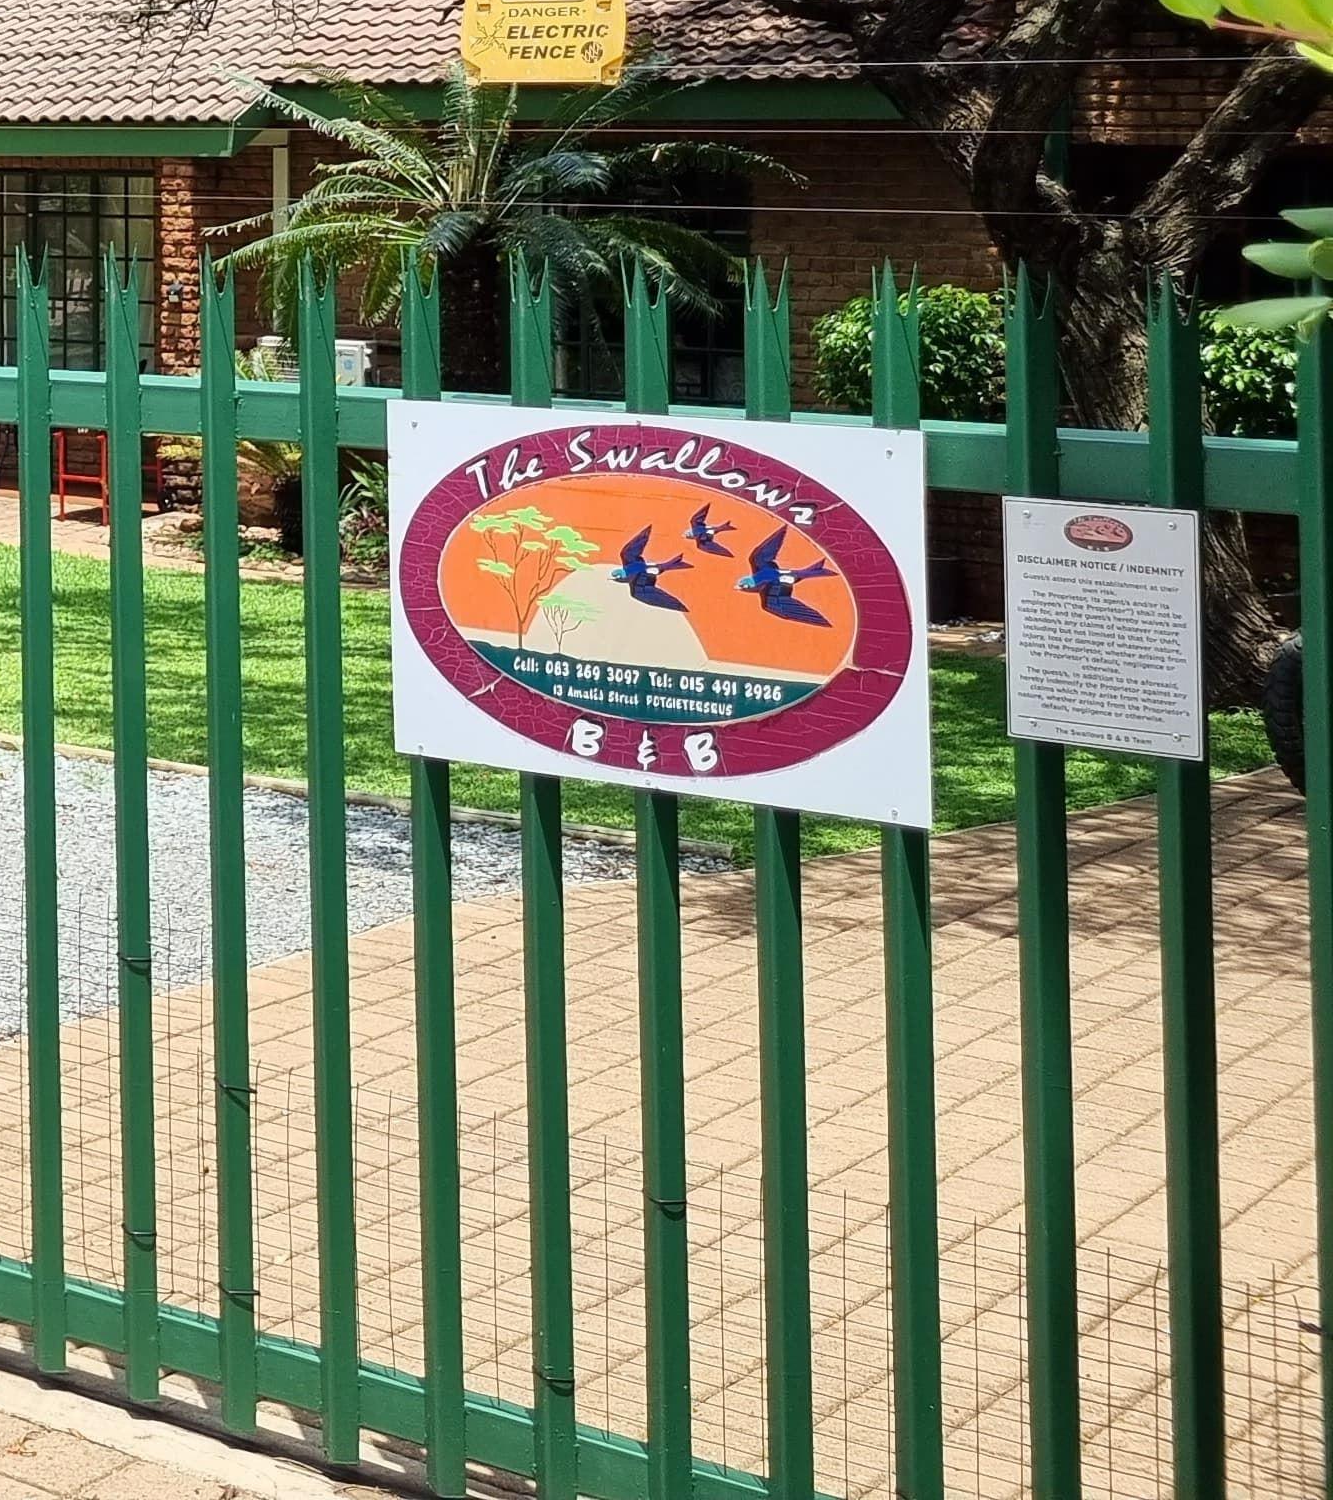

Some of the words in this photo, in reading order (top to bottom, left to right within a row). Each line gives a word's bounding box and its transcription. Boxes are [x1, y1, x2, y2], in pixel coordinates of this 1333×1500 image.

[508, 7, 580, 18] DANGER
[506, 24, 609, 40] ELECTRIC
[508, 45, 576, 60] FENCE
[465, 445, 543, 499] The
[567, 431, 816, 525] Swallows
[1017, 554, 1077, 567] DISCLAIMER
[1080, 560, 1116, 570] NOTICE
[1126, 564, 1184, 577] INDEMNITY
[1051, 575, 1075, 583] attend
[1094, 578, 1147, 589] establishment
[1159, 584, 1178, 592] their
[1079, 620, 1103, 628] claims
[1116, 624, 1151, 633] whatever
[1113, 615, 1137, 624] hereby
[1022, 623, 1056, 633] including
[1018, 639, 1045, 649] against
[1105, 649, 1135, 657] whether
[1138, 652, 1164, 662] arising
[1167, 655, 1186, 663] from
[1074, 637, 1104, 647] damage
[1116, 641, 1151, 651] whatever
[1123, 659, 1163, 671] negligence
[513, 656, 539, 674] Cell:
[576, 663, 600, 681] 269
[607, 666, 640, 685] 3097
[648, 671, 672, 688] Tel:
[679, 676, 704, 693] 015
[711, 678, 737, 696] 491
[745, 682, 782, 702] 2926
[1082, 672, 1113, 681] addition
[553, 684, 563, 697] 13
[1019, 674, 1043, 683] hereby
[1046, 677, 1083, 688] indemnify
[1100, 683, 1139, 694] Proprietor
[1142, 688, 1170, 698] against
[1030, 684, 1054, 692] claims
[1140, 696, 1177, 706] whatever
[1046, 693, 1076, 703] whether
[1079, 697, 1103, 707] arising
[1107, 701, 1125, 709] from
[1072, 705, 1111, 717] negligence
[572, 718, 604, 756] B
[684, 732, 718, 771] B
[1070, 728, 1104, 739] Swallows
[1132, 736, 1152, 745] Team
